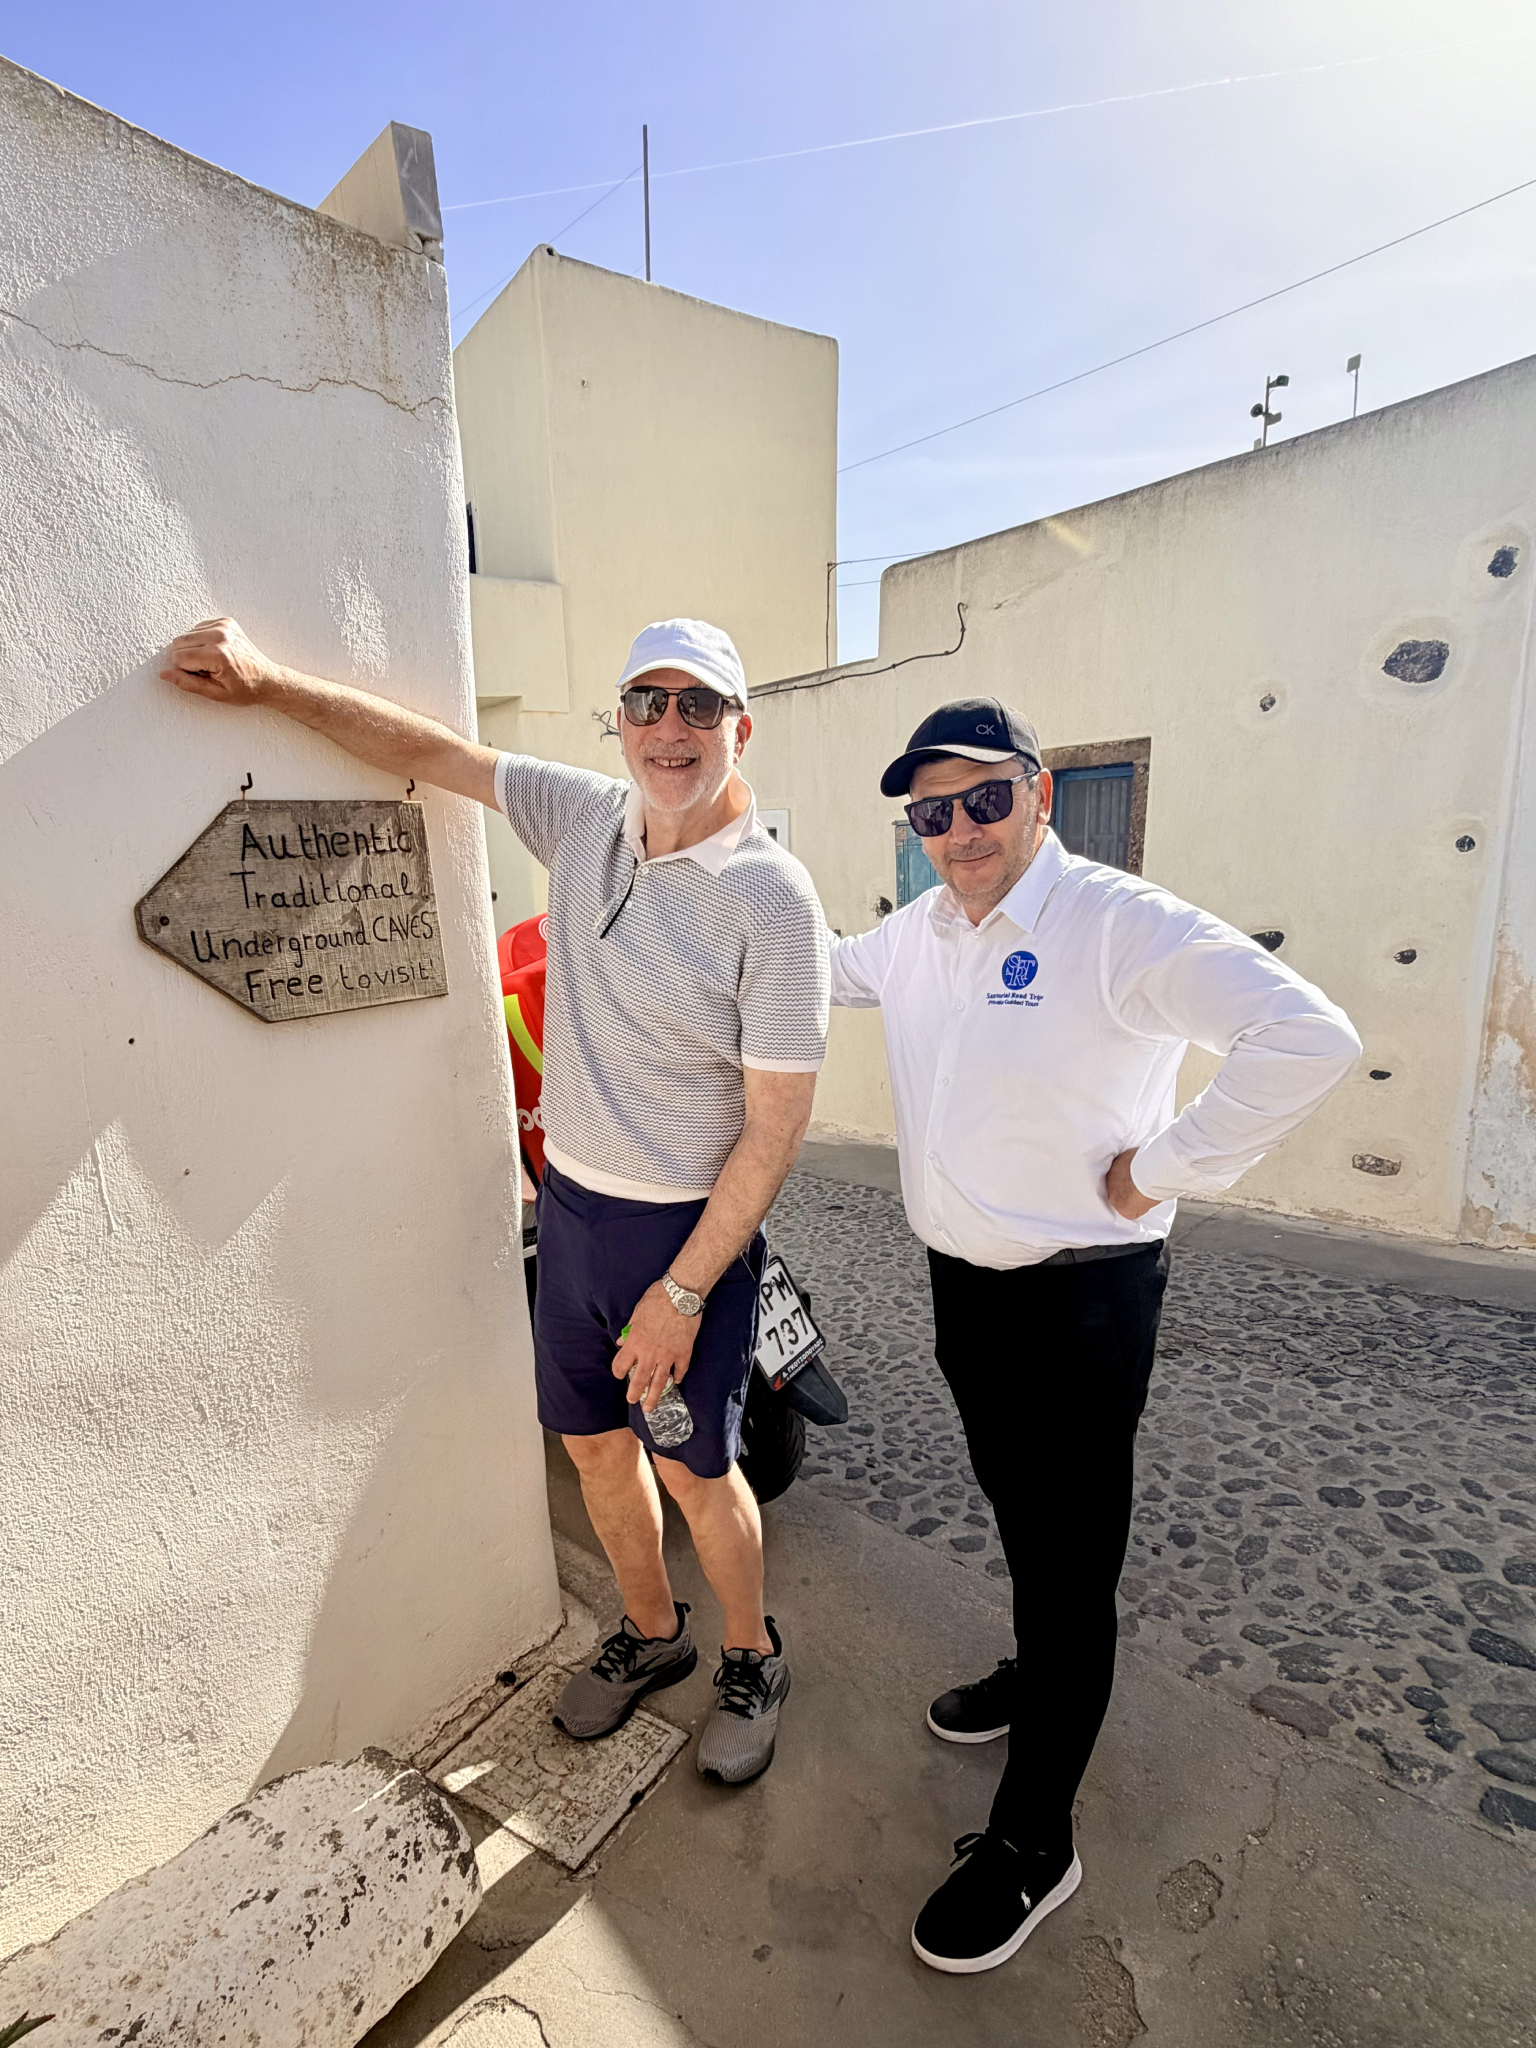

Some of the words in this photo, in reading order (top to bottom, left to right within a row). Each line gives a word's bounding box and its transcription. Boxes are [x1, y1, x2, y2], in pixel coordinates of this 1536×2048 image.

[976, 724, 995, 736] CK
[241, 823, 412, 861] Authentic
[229, 871, 413, 910] Traditional
[190, 920, 371, 968] Underground
[372, 911, 434, 942] CAVES
[245, 969, 324, 1003] Free
[765, 1306, 809, 1357] 737
